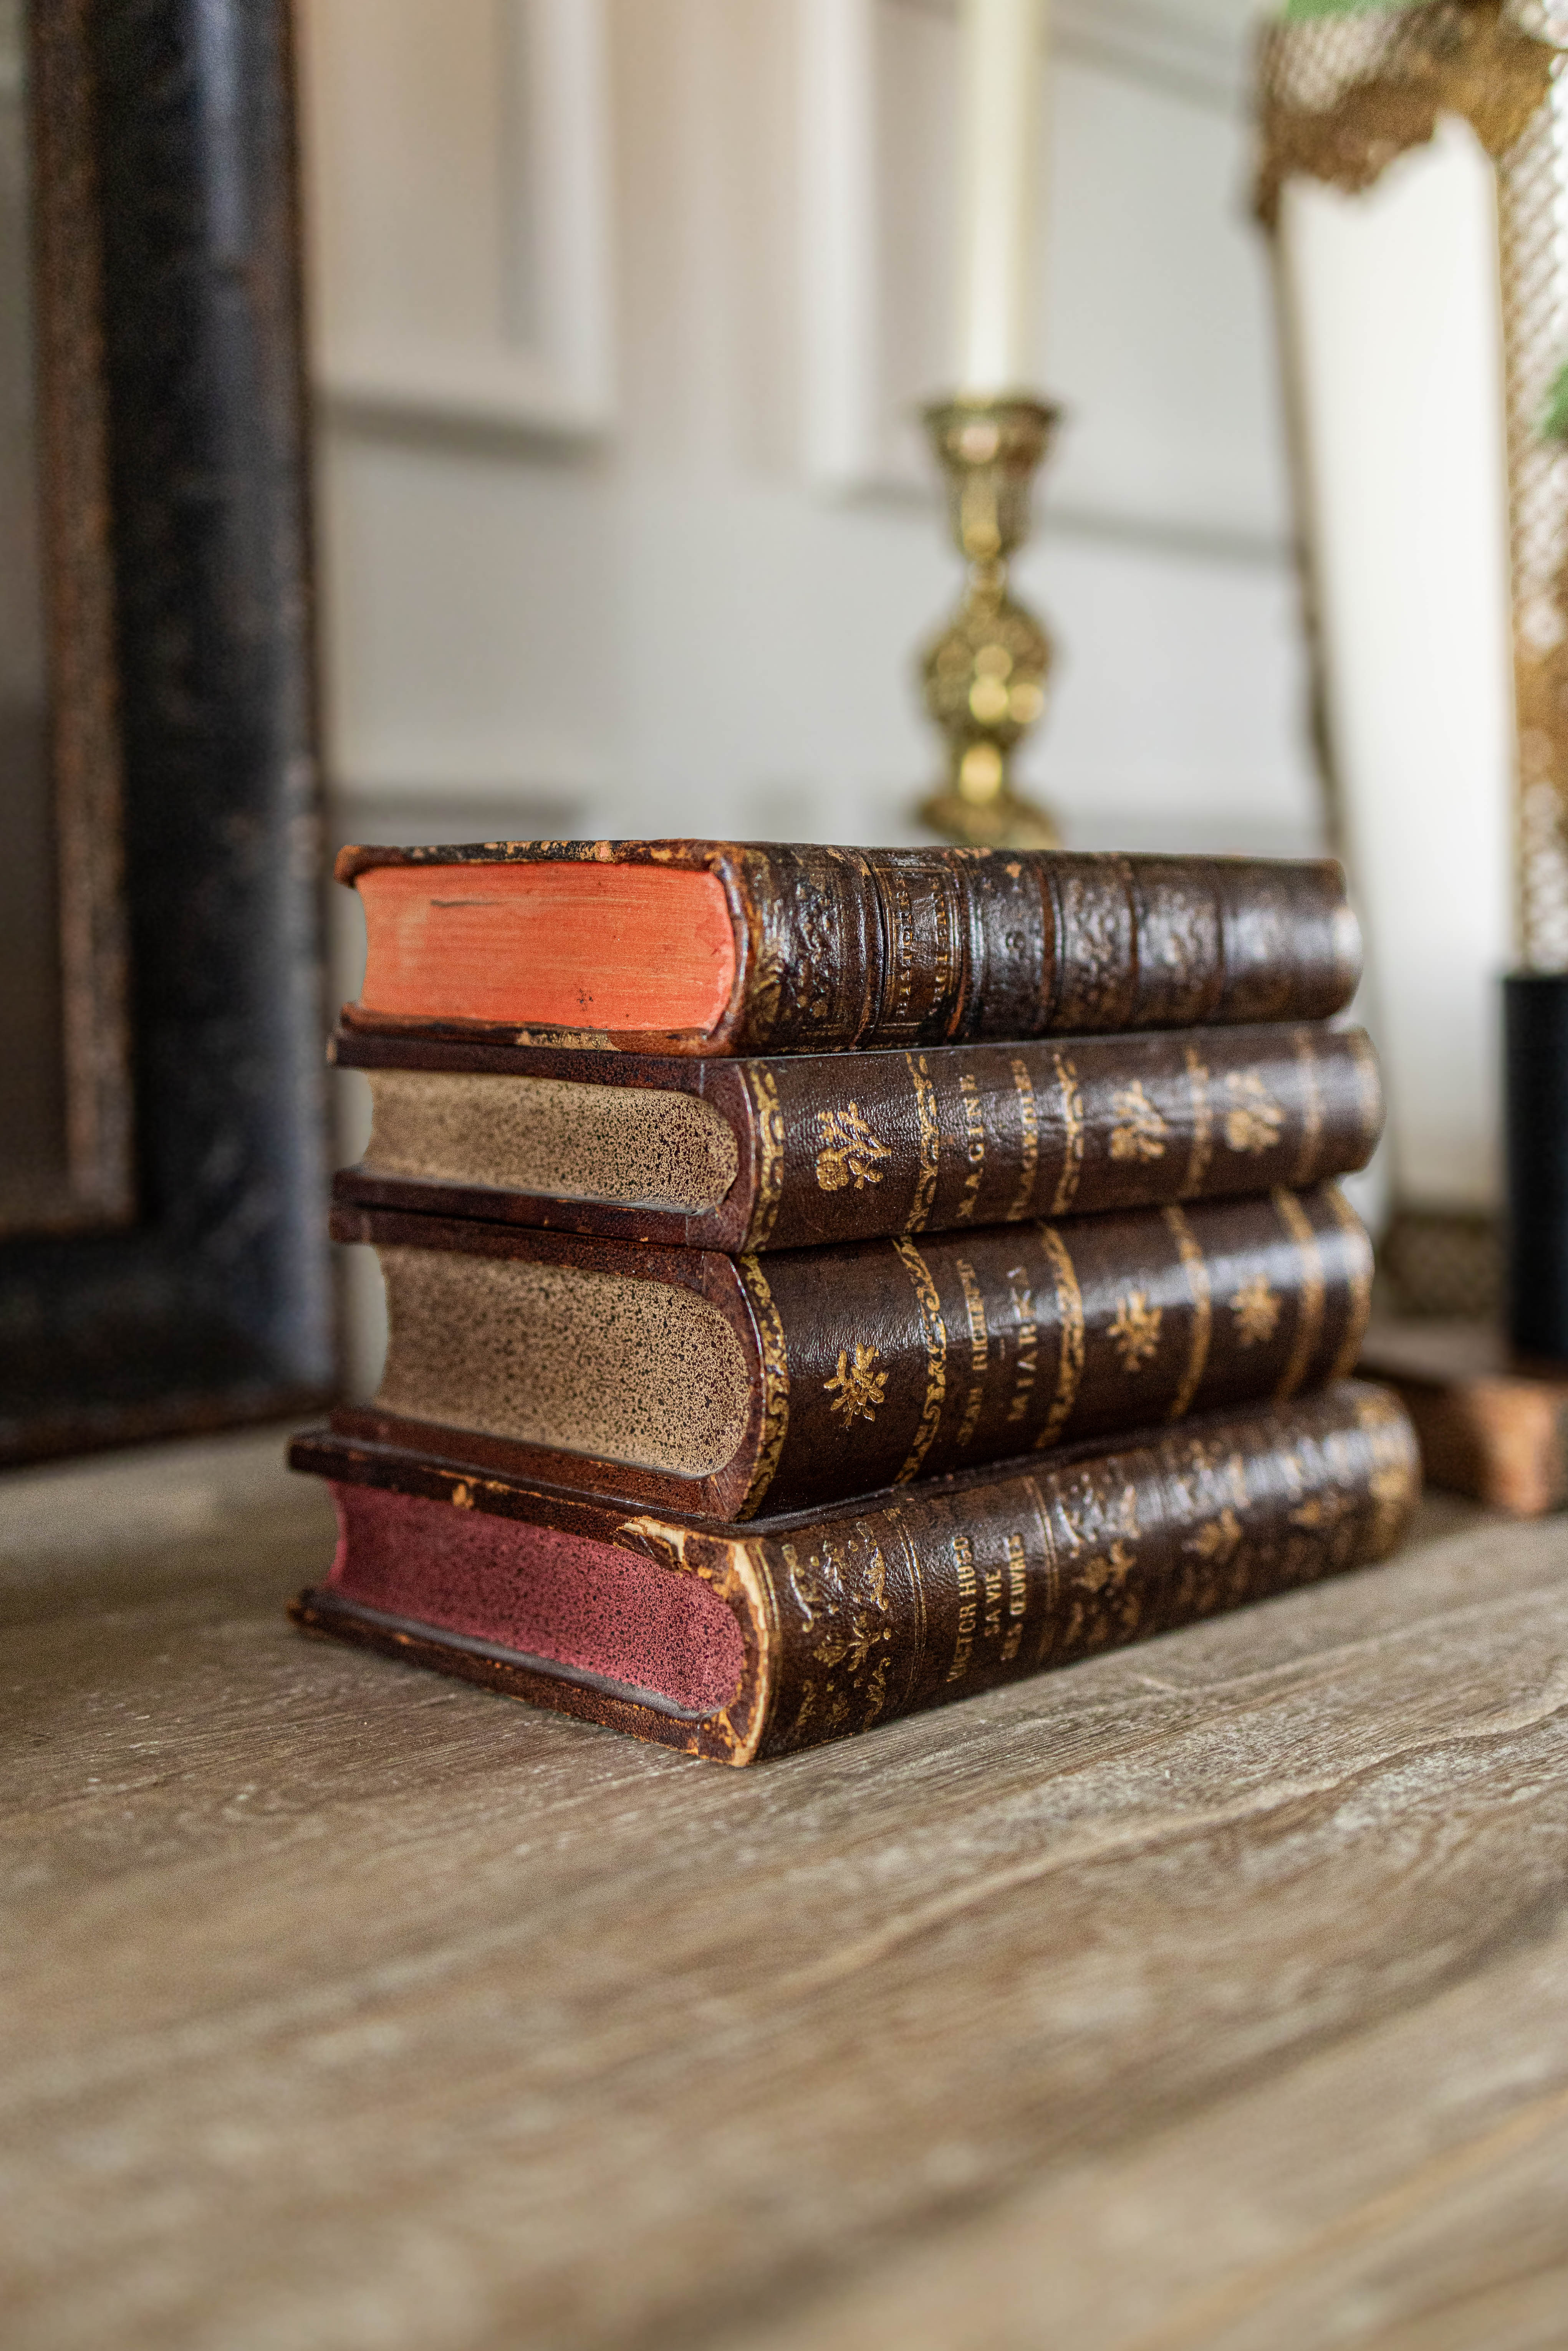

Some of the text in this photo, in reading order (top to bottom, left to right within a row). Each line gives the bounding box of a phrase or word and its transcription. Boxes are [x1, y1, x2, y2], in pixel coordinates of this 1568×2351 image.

[956, 1074, 985, 1218] RACINE
[945, 1536, 977, 1683] VICTOR HUGO
[984, 1569, 1002, 1637] SA VIE
[1003, 1534, 1027, 1615] ŒUVRES
